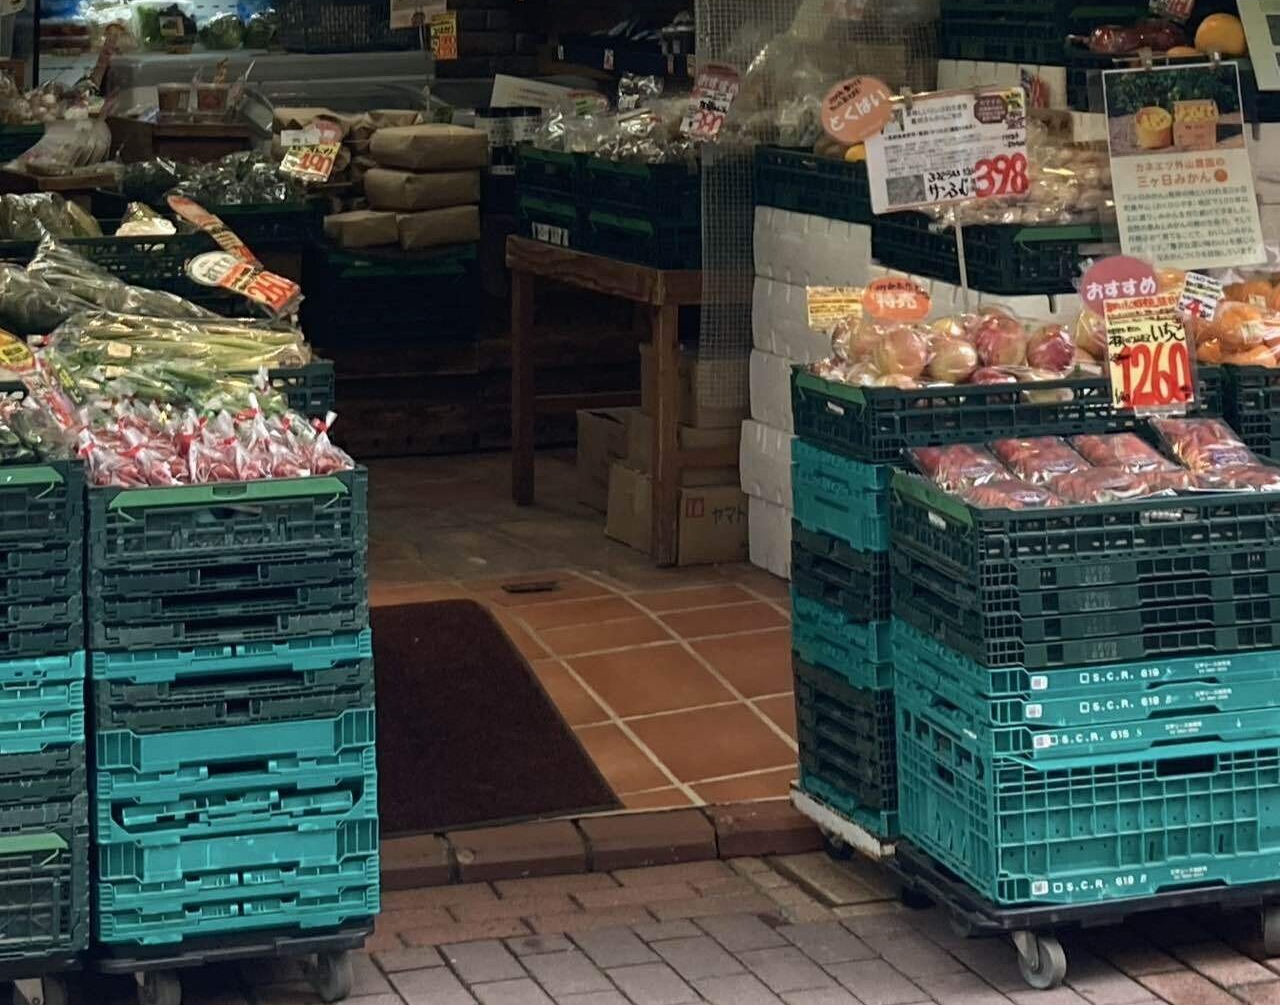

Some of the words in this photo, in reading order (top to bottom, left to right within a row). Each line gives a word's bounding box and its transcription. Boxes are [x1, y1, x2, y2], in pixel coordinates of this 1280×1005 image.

[830, 90, 888, 132] とくばい
[975, 152, 1029, 198] 398
[1086, 275, 1157, 301] おすすめ
[1150, 322, 1186, 343] いちご
[1115, 342, 1194, 407] 1260
[1092, 671, 1135, 683] S.C.R.
[1092, 699, 1135, 711] S.C.R.
[1061, 732, 1104, 744] S.C.R.
[1066, 879, 1109, 892] S.C.R.
